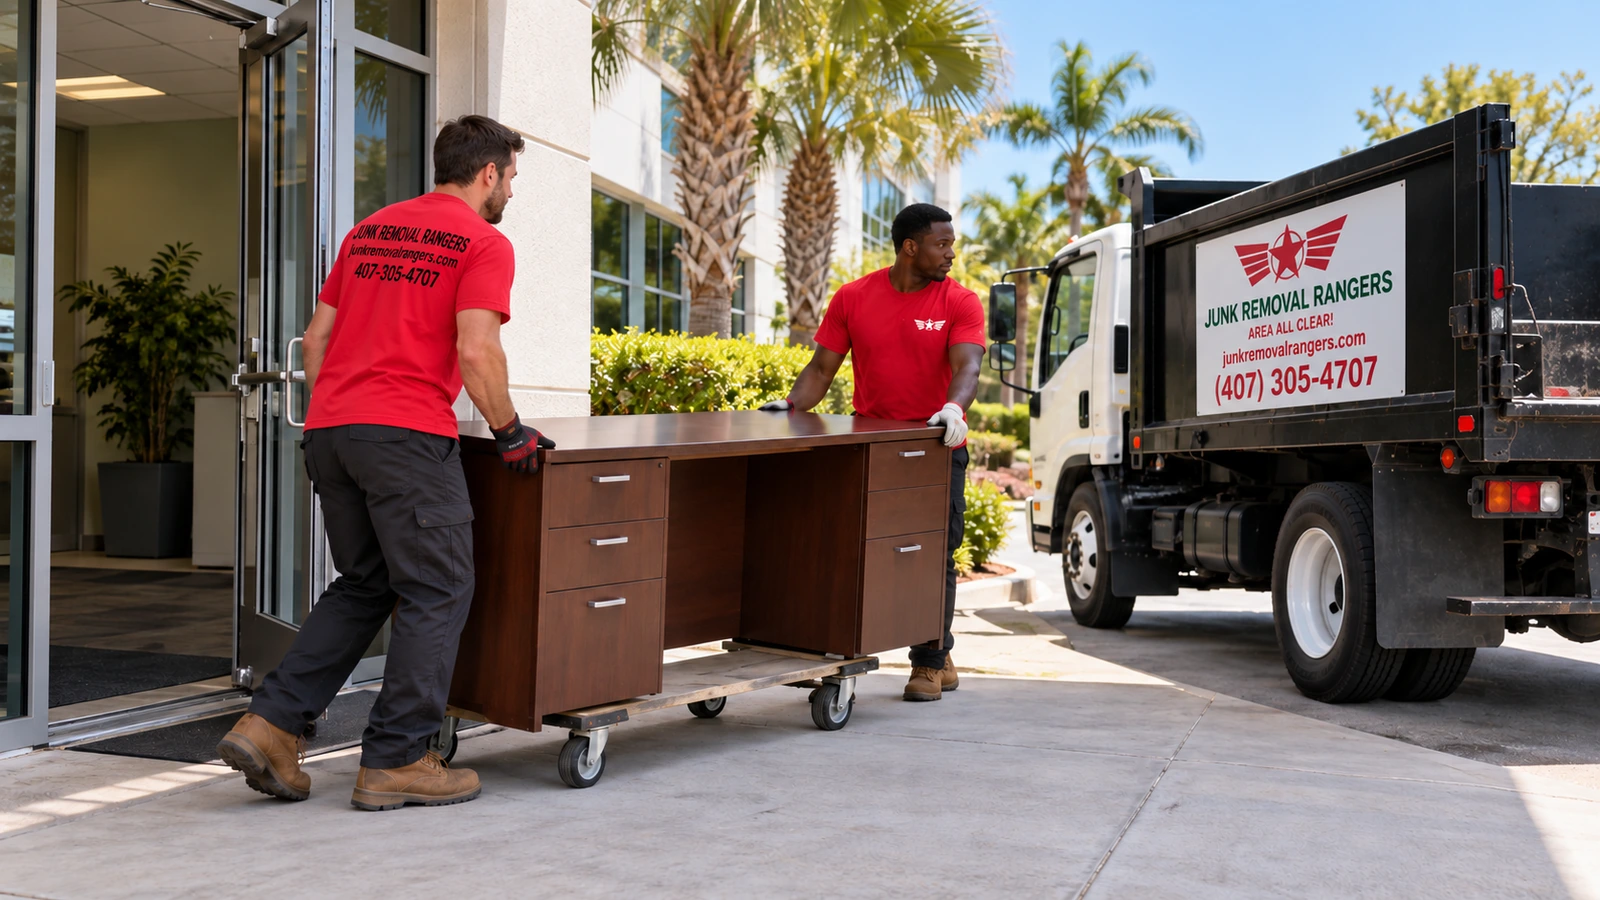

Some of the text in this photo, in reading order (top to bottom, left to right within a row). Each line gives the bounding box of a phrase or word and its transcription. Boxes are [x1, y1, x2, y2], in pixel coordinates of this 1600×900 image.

[353, 224, 471, 253] JUNK REMOVAL RANGERS
[348, 244, 459, 269] junkremovalrangers.com
[354, 262, 440, 288] 407-305-4707
[1204, 270, 1393, 328] JUNK REMOVAL RANGERS
[1248, 312, 1334, 340] AREA ALL CLEAR!
[1222, 332, 1366, 369] junkremovalrangers.com
[1215, 355, 1378, 406] (407) 305-4707
